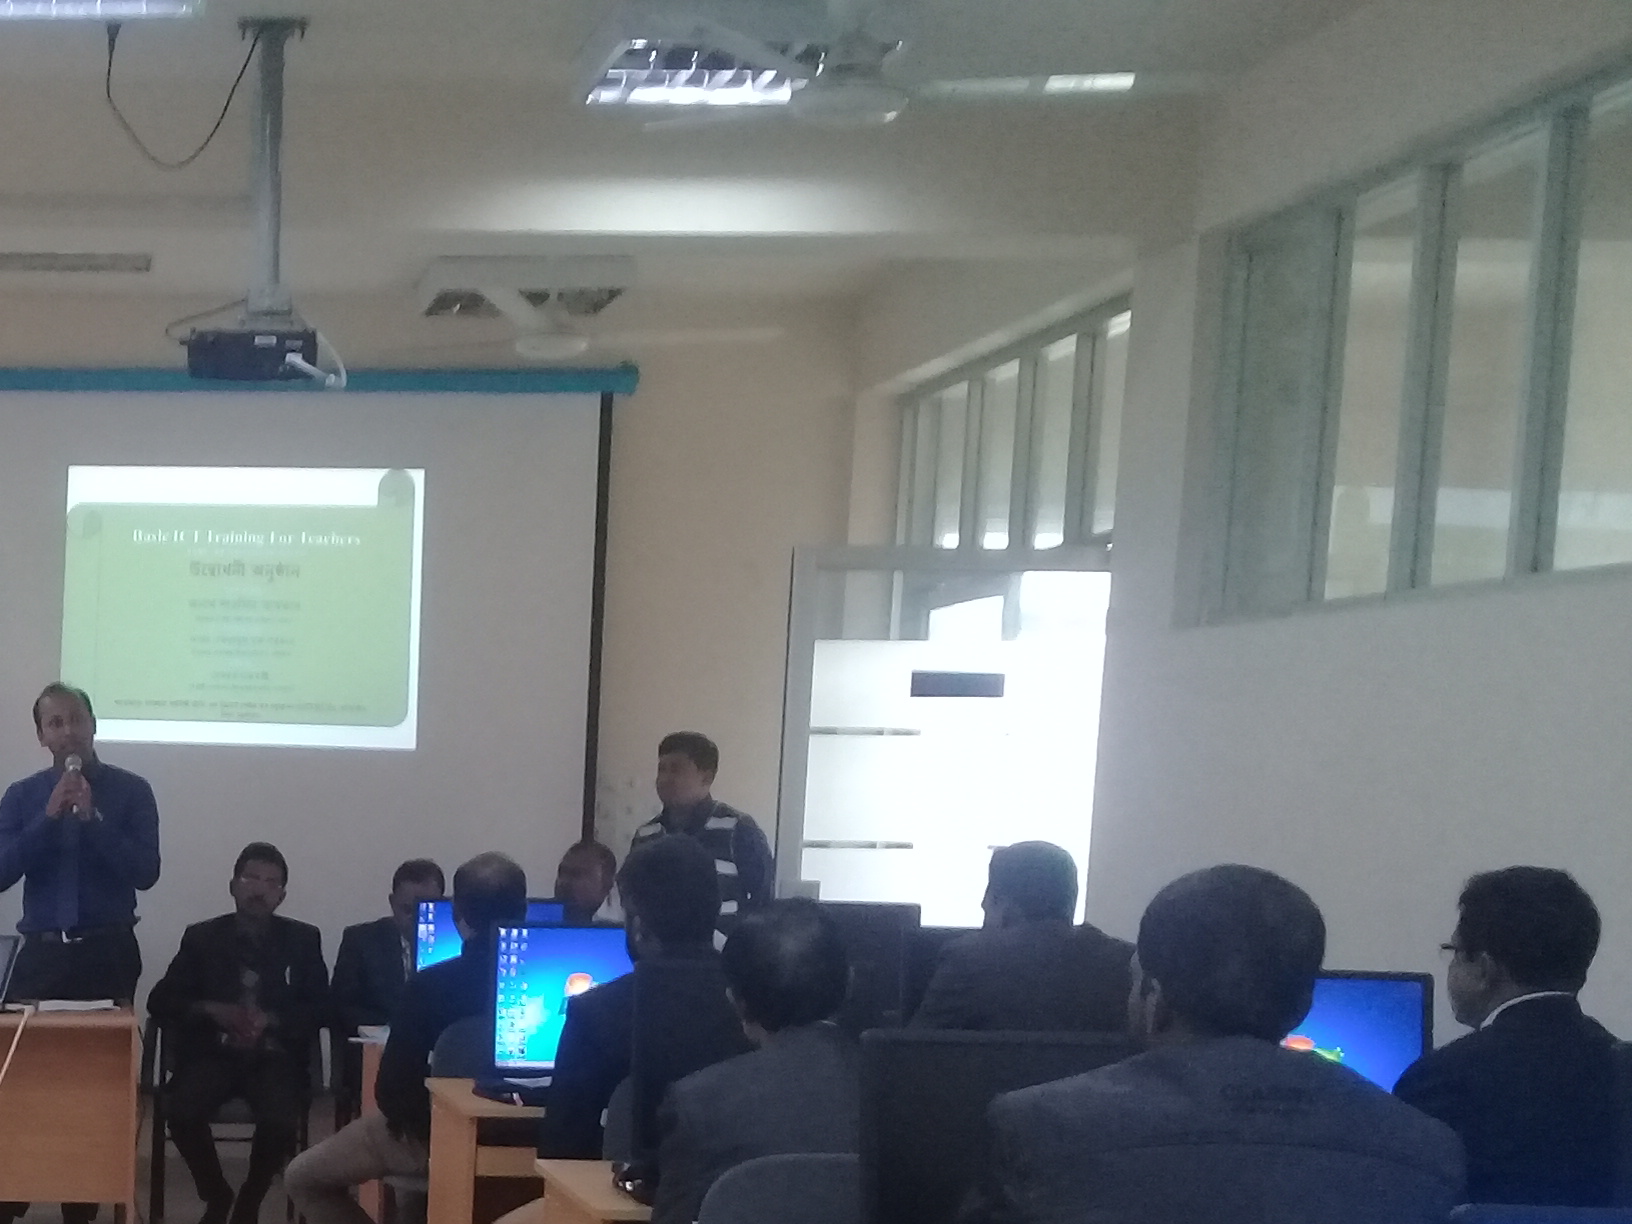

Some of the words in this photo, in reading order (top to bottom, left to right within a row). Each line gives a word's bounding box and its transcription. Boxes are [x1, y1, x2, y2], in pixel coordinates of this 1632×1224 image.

[132, 528, 169, 545] Basic
[173, 529, 199, 545] ICT
[207, 529, 265, 547] Training
[270, 530, 293, 545] For
[301, 530, 362, 547] Teachers
